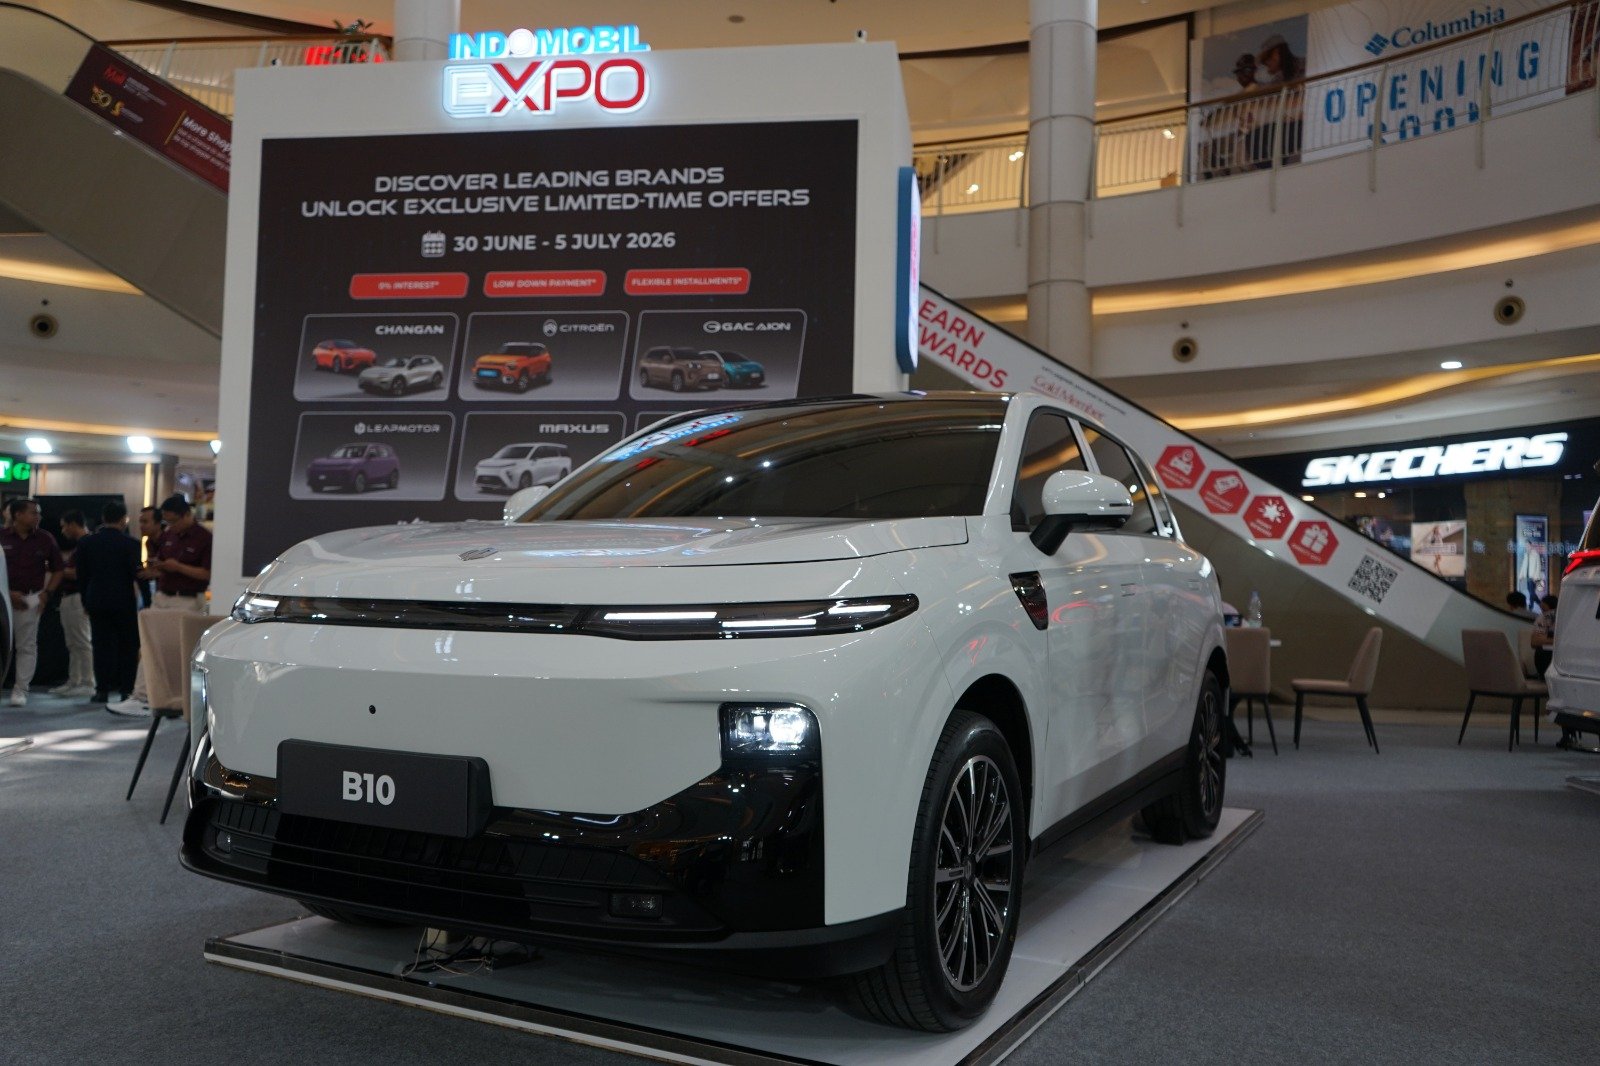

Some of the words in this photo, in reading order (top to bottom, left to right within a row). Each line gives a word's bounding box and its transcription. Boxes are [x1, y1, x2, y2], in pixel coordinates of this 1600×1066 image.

[1390, 6, 1506, 49] Columbia
[448, 25, 651, 60] INDOMOBIL
[443, 58, 650, 118] EXPO
[1324, 41, 1540, 124] OPENING
[182, 116, 209, 137] More
[375, 173, 498, 193] DISCOVER
[503, 170, 610, 190] LEADING
[615, 167, 725, 187] BRANDS
[301, 199, 398, 218] UNLOCK
[403, 195, 540, 216] EXCLUSIVE
[545, 191, 703, 212] LIMITED-TIME
[708, 189, 810, 208] OFFERS
[453, 236, 479, 252] 30
[482, 235, 537, 251] JUNE
[554, 234, 567, 250] 5
[571, 233, 622, 250] JULY
[626, 232, 676, 249] 2026
[493, 280, 515, 288] LOW
[516, 279, 548, 288] DOWN
[631, 278, 673, 287] FLEXIBLE
[375, 325, 445, 335] CHANGAN
[722, 321, 755, 332] GAC
[755, 321, 791, 332] AION
[918, 299, 986, 349] EARN
[917, 323, 1009, 389] WARDS
[366, 423, 441, 434] LEAPMOTOR
[539, 423, 610, 434] MAXUS
[1302, 432, 1568, 487] SKECHERS
[342, 770, 396, 806] B10
